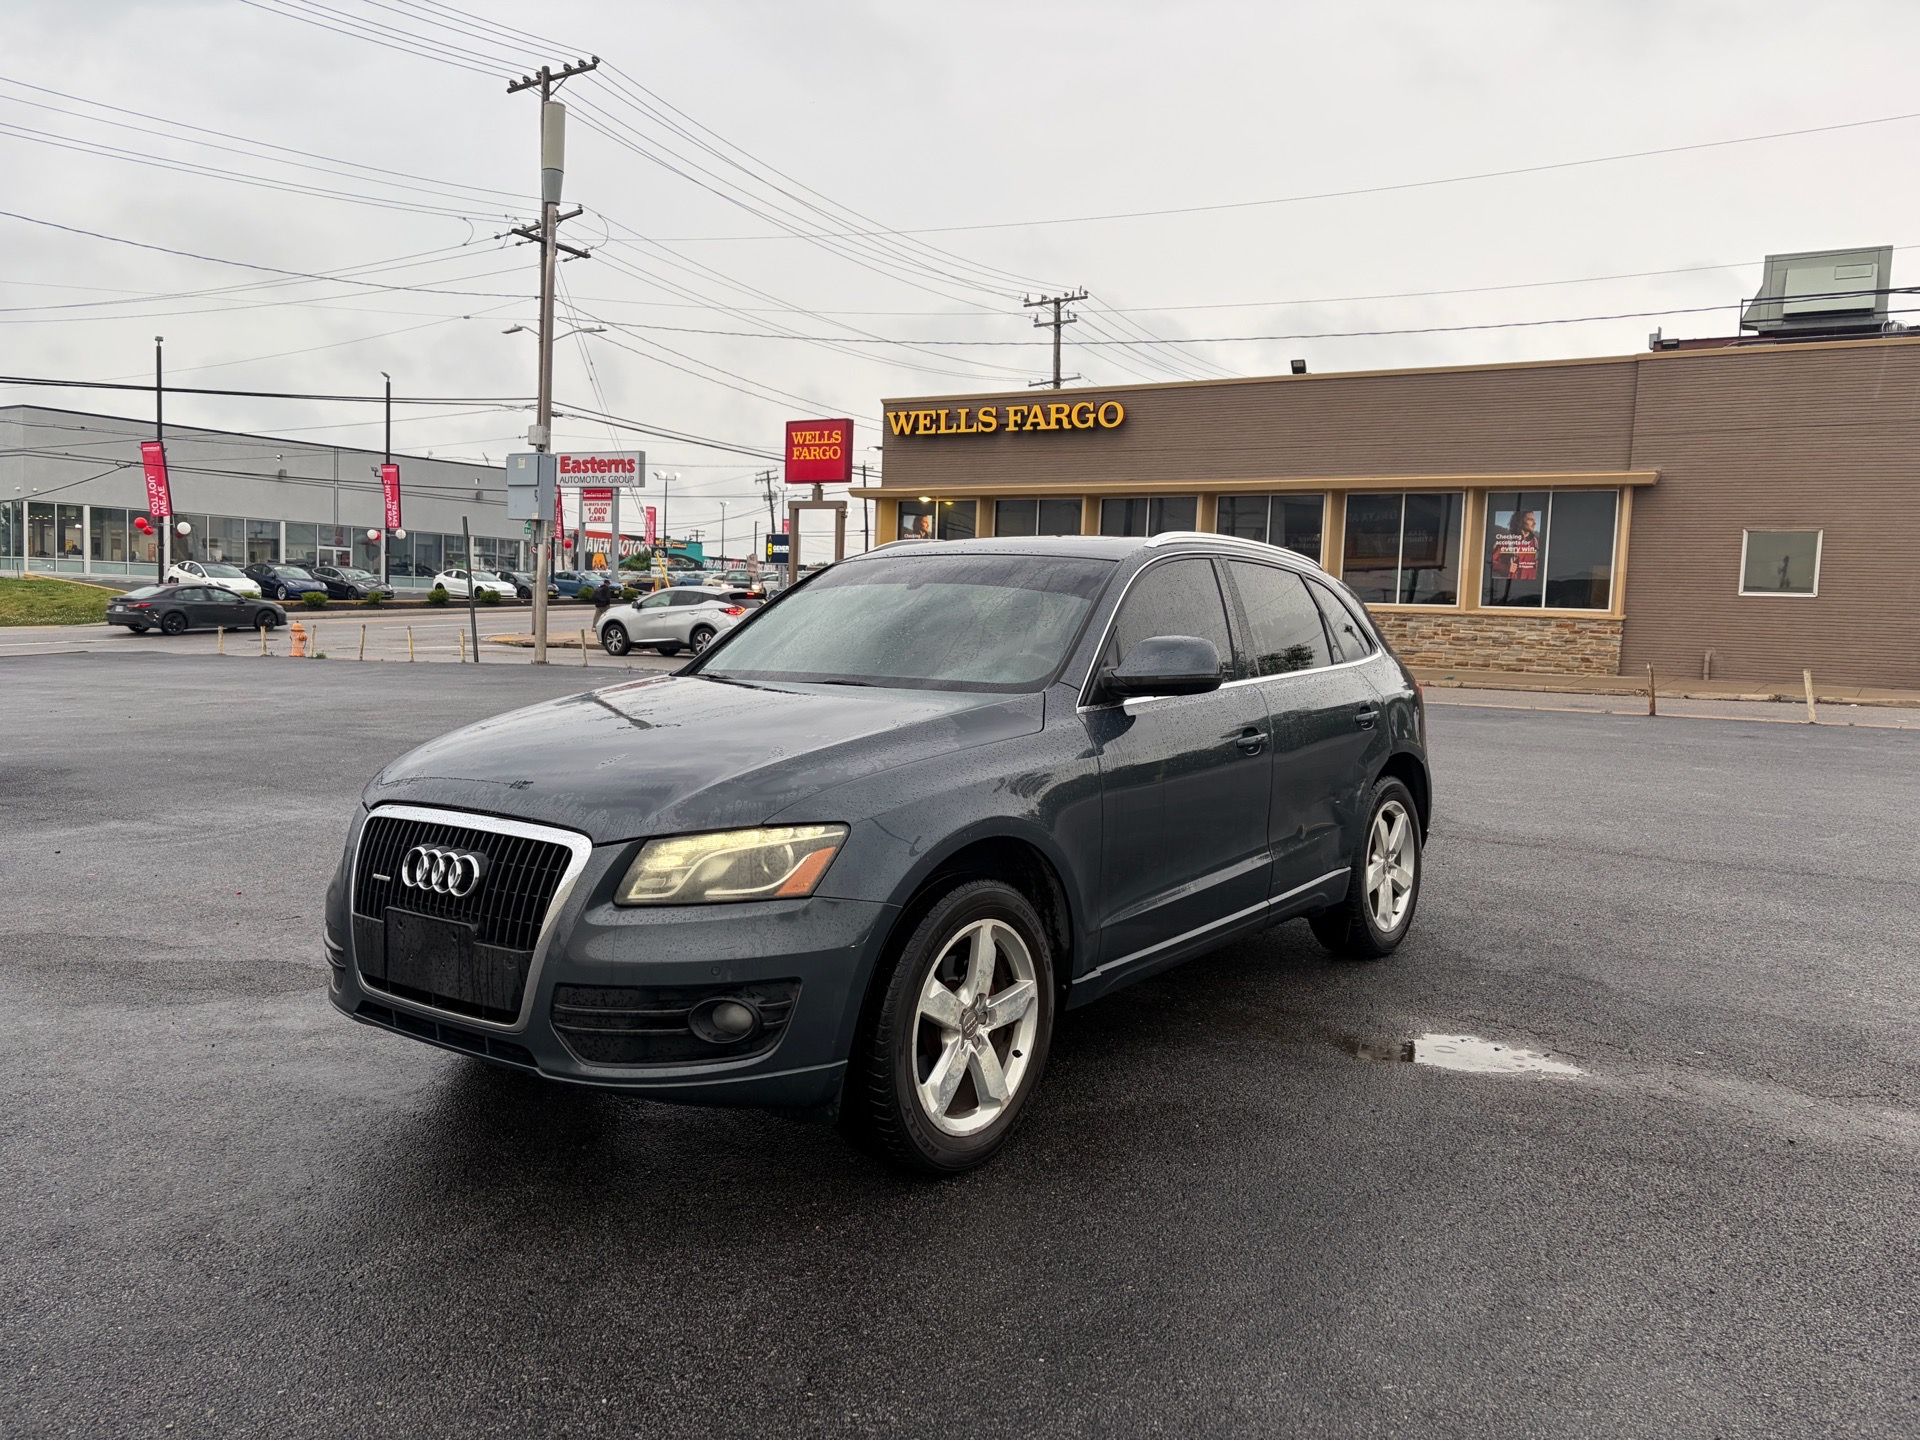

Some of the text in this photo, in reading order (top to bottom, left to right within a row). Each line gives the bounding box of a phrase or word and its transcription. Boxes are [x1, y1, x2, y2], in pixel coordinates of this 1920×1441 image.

[886, 401, 1125, 436] WELLS FARGO
[791, 430, 842, 445] WELLS
[792, 446, 841, 460] FARGO
[560, 456, 635, 474] Easterns
[560, 475, 635, 484] AUTOMOTIVE GROUP
[588, 507, 607, 515] 1,000
